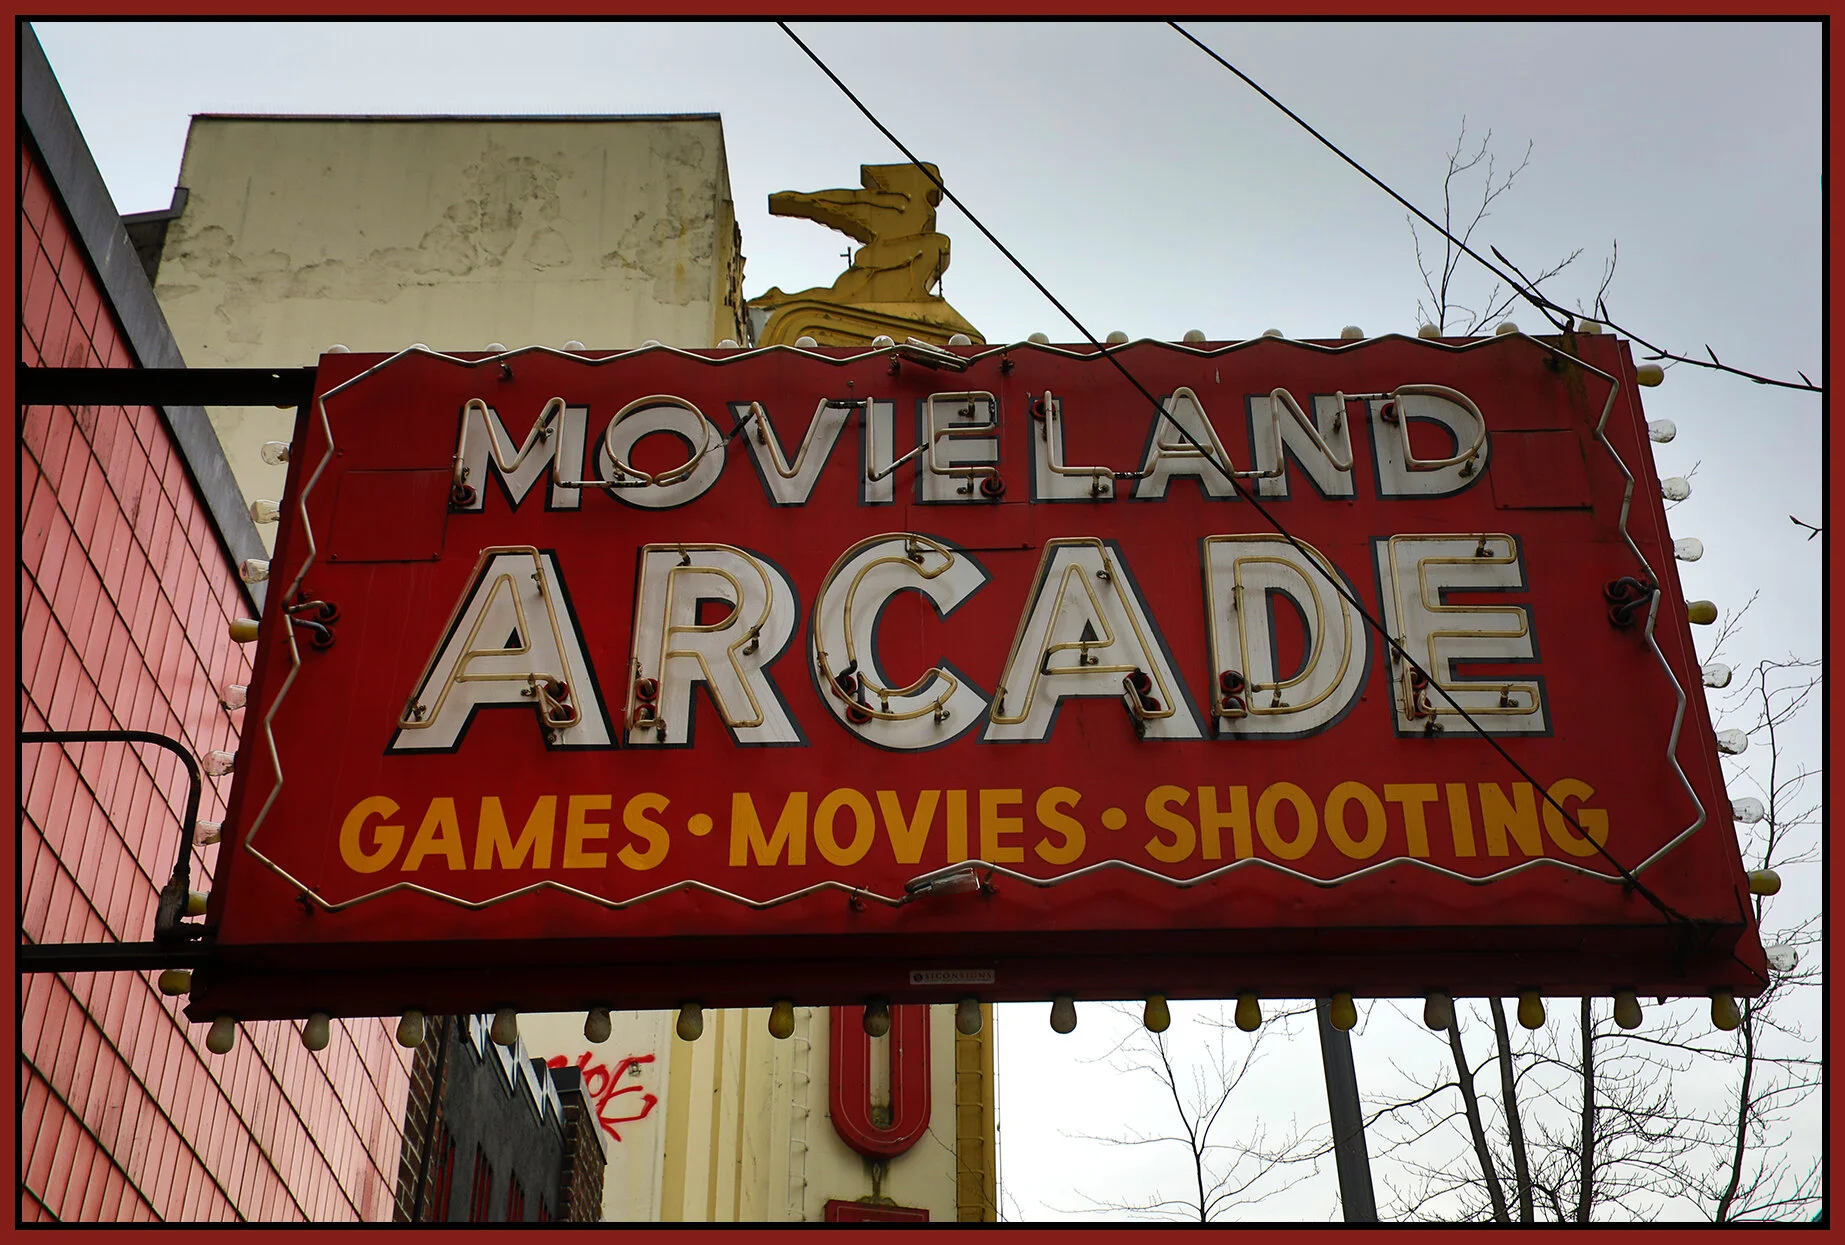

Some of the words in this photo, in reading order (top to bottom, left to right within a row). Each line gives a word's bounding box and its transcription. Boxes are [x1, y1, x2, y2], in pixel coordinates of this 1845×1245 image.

[449, 385, 1491, 513] MOVIELAND
[385, 532, 1553, 753] ARCADE
[338, 793, 672, 875] GAMES
[728, 786, 1086, 868] MOVIES
[1144, 778, 1610, 864] SHOOTING
